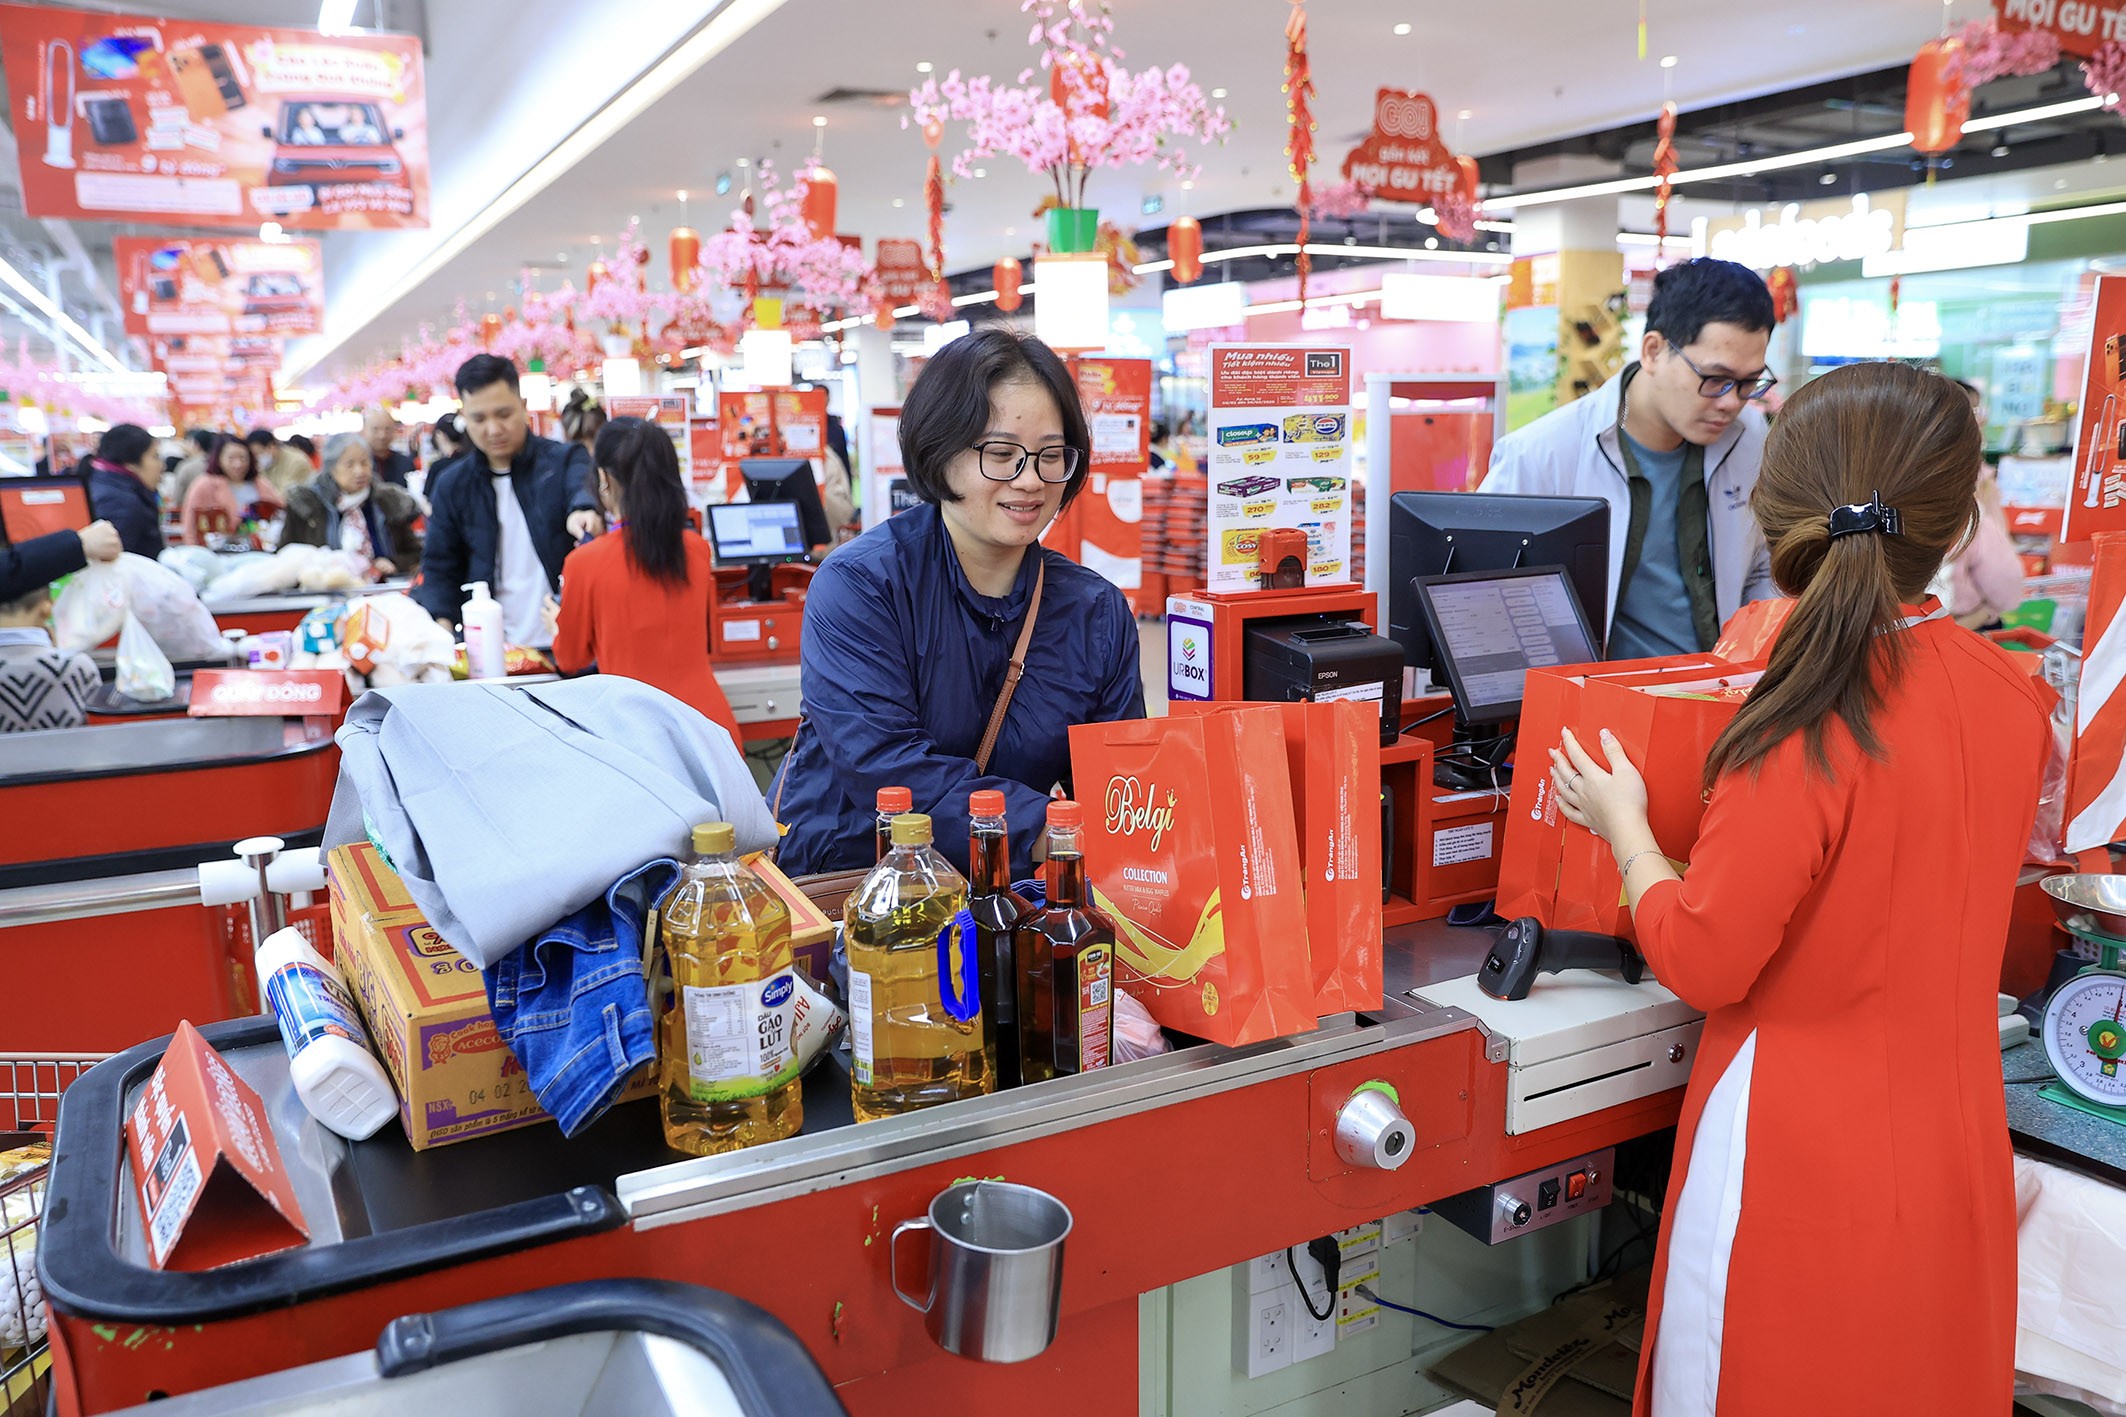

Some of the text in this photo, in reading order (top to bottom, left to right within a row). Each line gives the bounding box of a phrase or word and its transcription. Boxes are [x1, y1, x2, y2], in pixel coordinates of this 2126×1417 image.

[2058, 1, 2097, 35] GU
[1389, 167, 1419, 191] GU
[1224, 352, 1253, 361] Mua
[1225, 430, 1253, 438] closeup
[1173, 660, 1205, 681] URBOX
[1318, 671, 1338, 679] EPSON
[1104, 775, 1177, 852] Belgi
[1123, 867, 1168, 884] COLLECTION
[764, 982, 793, 1002] Simply
[451, 1025, 475, 1039] Cook
[758, 1014, 783, 1034] GẠO
[469, 1089, 485, 1104] 04
[495, 1083, 511, 1098] 02
[464, 1120, 483, 1131] phẩm
[499, 1111, 518, 1122] tháng
